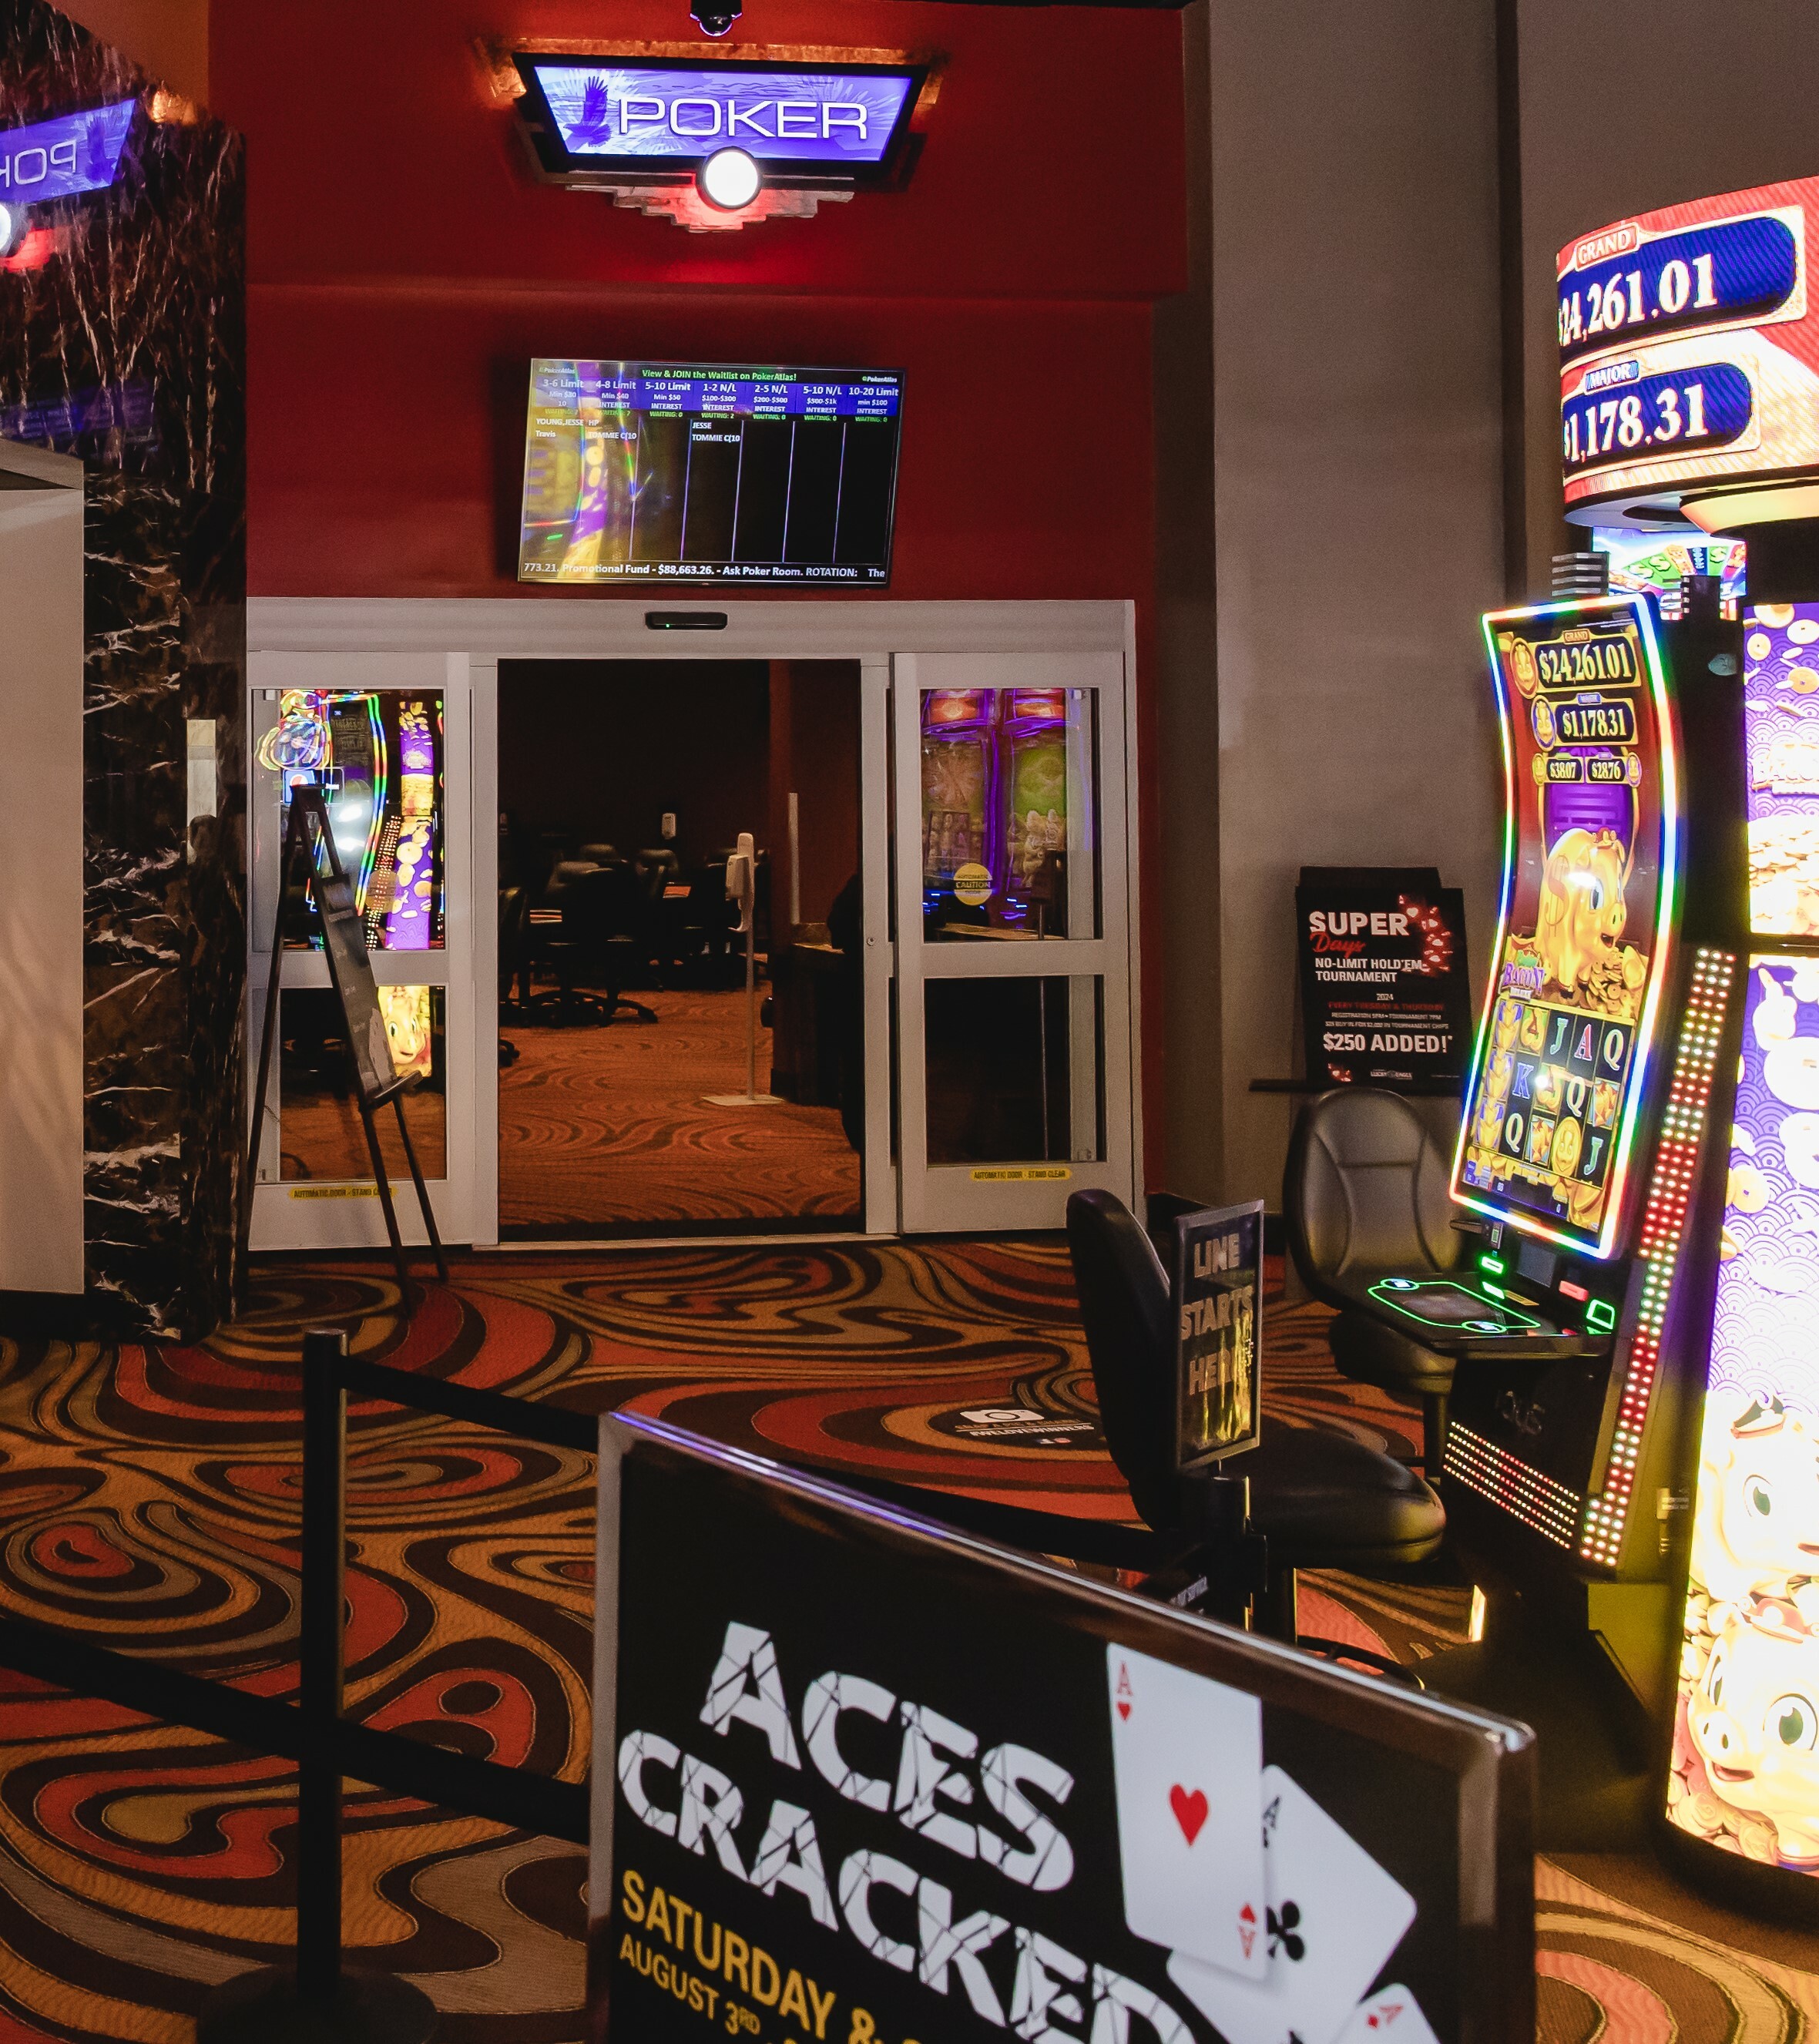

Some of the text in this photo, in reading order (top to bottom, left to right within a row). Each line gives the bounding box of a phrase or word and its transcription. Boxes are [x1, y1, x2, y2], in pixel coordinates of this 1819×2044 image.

[619, 96, 868, 140] POKER
[1578, 229, 1632, 265] GRAND
[543, 379, 584, 388] 3-6 Limit
[596, 380, 636, 389] 4-8 Limit
[645, 381, 691, 391] 5-10 Limit
[720, 383, 737, 393] N/L
[752, 373, 797, 382] PokerAtlas!
[754, 384, 788, 394] 2-5 N/L
[803, 385, 841, 396] 5-10 N/L
[849, 387, 898, 396] 10-20 Limit
[1589, 367, 1631, 388] MAJOR
[524, 562, 559, 572] 773.21.
[562, 563, 623, 575] Promotional
[625, 564, 649, 574] Fund
[658, 564, 715, 576] $88,663.26.
[723, 566, 740, 576] Ask
[743, 566, 770, 576] Poker
[772, 566, 804, 576] Room.
[805, 567, 857, 577] ROTATION:
[868, 569, 885, 578] The
[1565, 632, 1588, 642] GRAND
[1309, 911, 1411, 937] SUPER
[1309, 931, 1368, 959] Days
[1314, 958, 1423, 972] NO-LIMIT HOLD'EM
[1314, 971, 1398, 983] TOURNAMENT
[1323, 1032, 1366, 1052] $250
[1550, 1017, 1569, 1055] J
[1573, 1023, 1593, 1061] A
[1603, 1029, 1625, 1072] Q
[1512, 1062, 1535, 1099] K
[1566, 1075, 1586, 1118] Q
[1505, 1113, 1525, 1153] Q
[1583, 1136, 1605, 1176] J
[1193, 1233, 1240, 1278] LINE
[1181, 1285, 1253, 1341] STARTS
[1116, 1661, 1133, 1697] A
[699, 1619, 1076, 1892] ACES
[622, 1869, 837, 2040] SATURDAY
[619, 1934, 762, 2036] AUGUST 3RD
